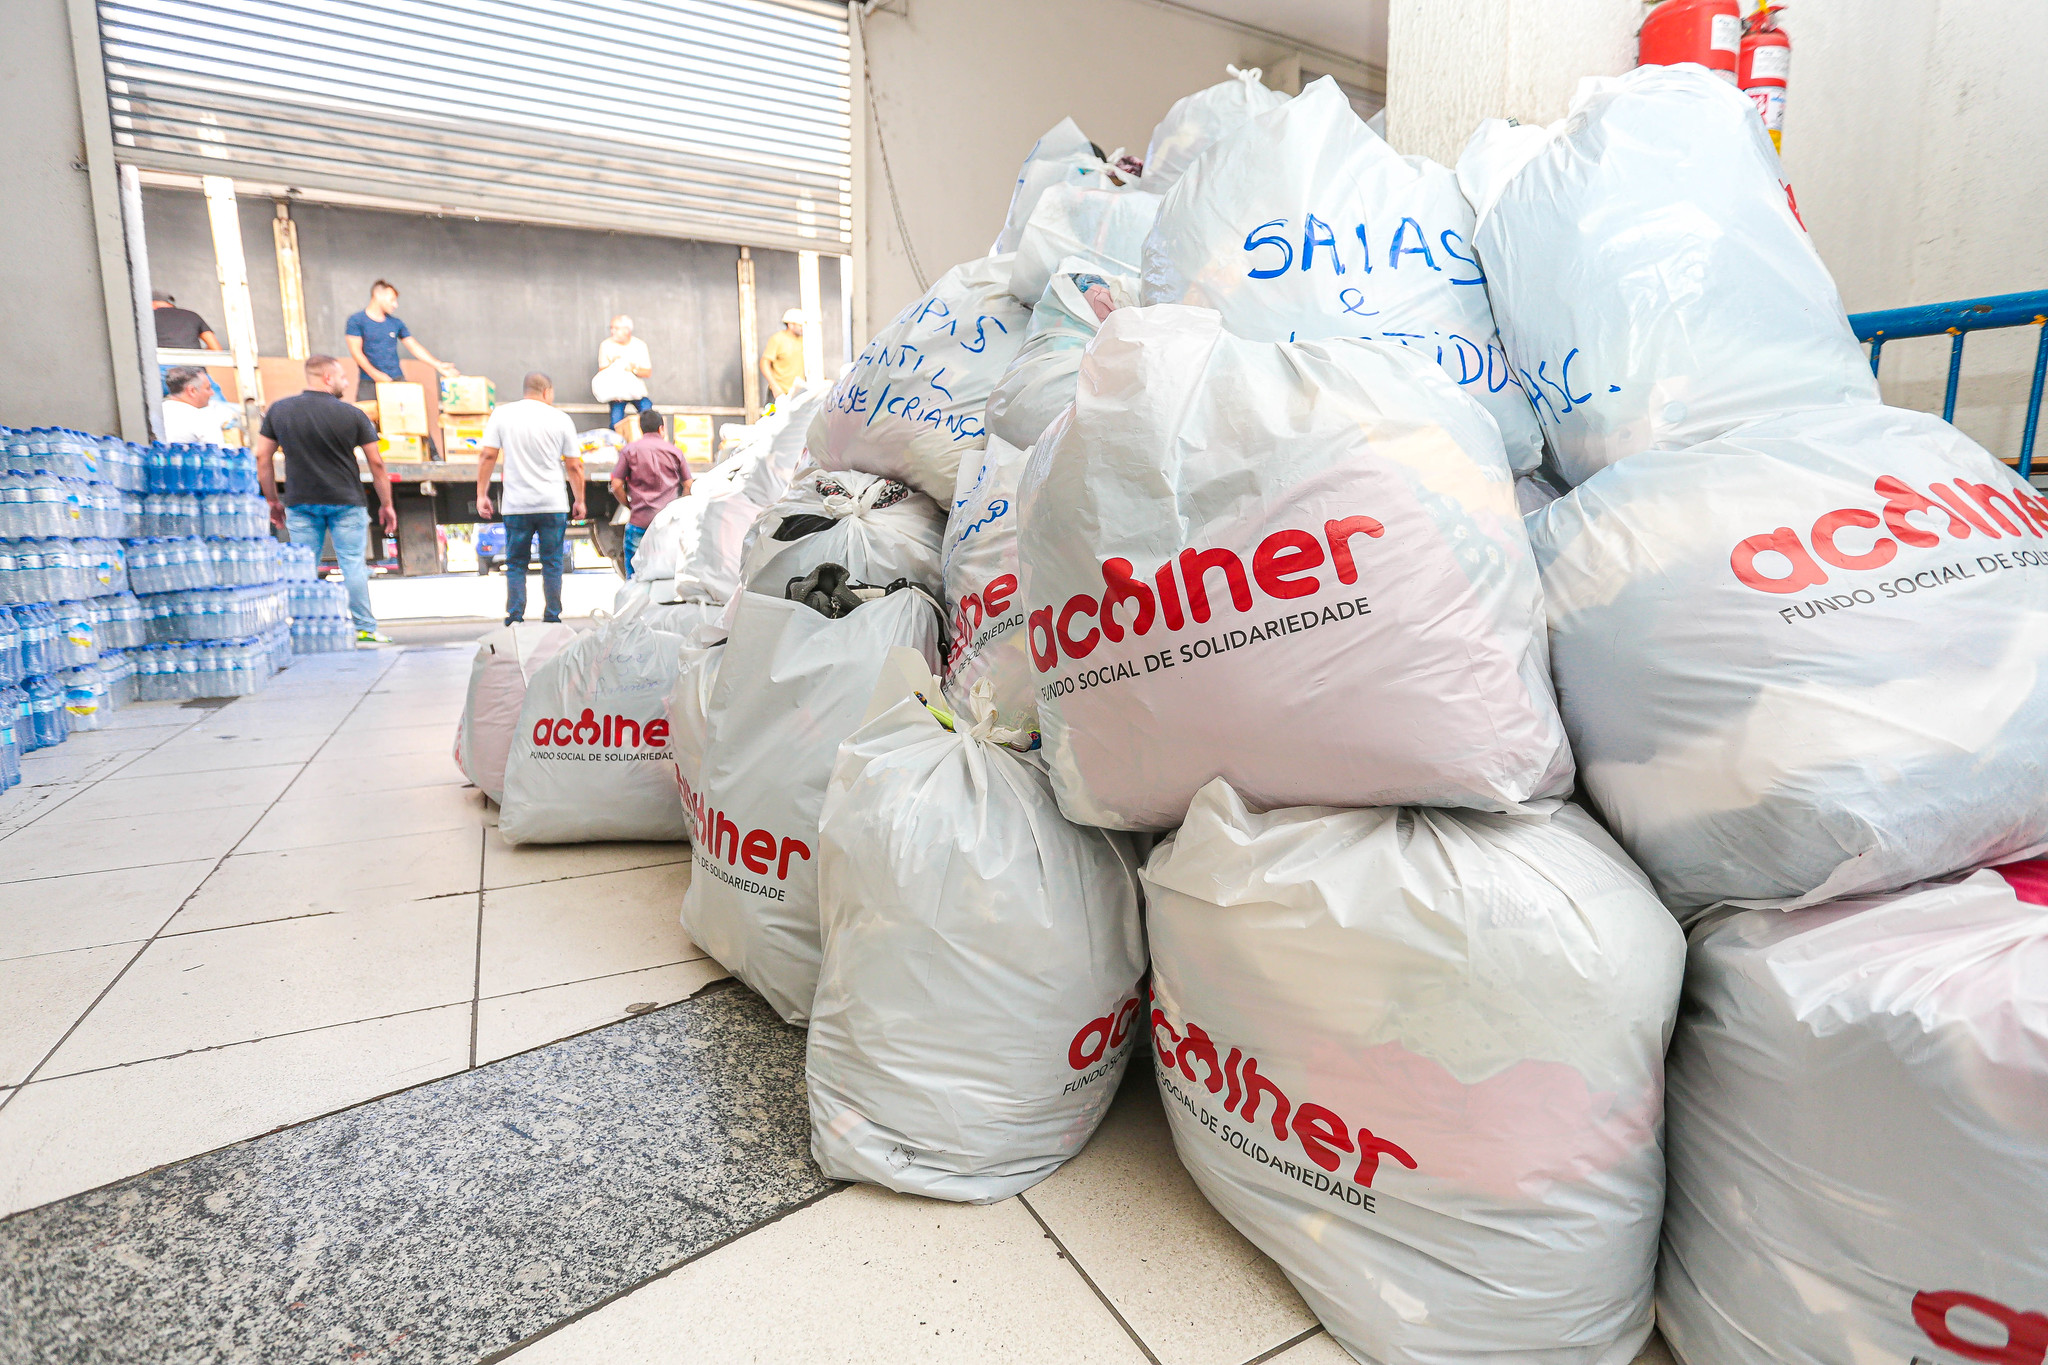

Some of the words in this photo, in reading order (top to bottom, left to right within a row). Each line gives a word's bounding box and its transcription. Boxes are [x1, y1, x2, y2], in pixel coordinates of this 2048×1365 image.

[1244, 213, 1488, 285] SAIAS
[1730, 474, 2048, 595] acolhe
[1778, 589, 1876, 625] FUNDO
[1879, 562, 1976, 599] SOCIAL
[1976, 552, 2013, 574] DE
[1041, 676, 1075, 702] FUNDO
[1078, 660, 1141, 690] SOCIAL
[1144, 649, 1175, 673] DE
[1182, 596, 1372, 664] SOLIDARIEDADE
[530, 751, 555, 761] FUNDO
[556, 751, 586, 762] SOCIAL
[588, 752, 601, 762] DE
[533, 708, 669, 748] acolhe
[710, 863, 786, 902] SOLIDARIEDADE
[1063, 1064, 1108, 1096] FUNDO
[1160, 1071, 1198, 1118] SOCIAL
[1200, 1107, 1218, 1134] DE
[1220, 1125, 1376, 1214] SOLIDARIEDADE
